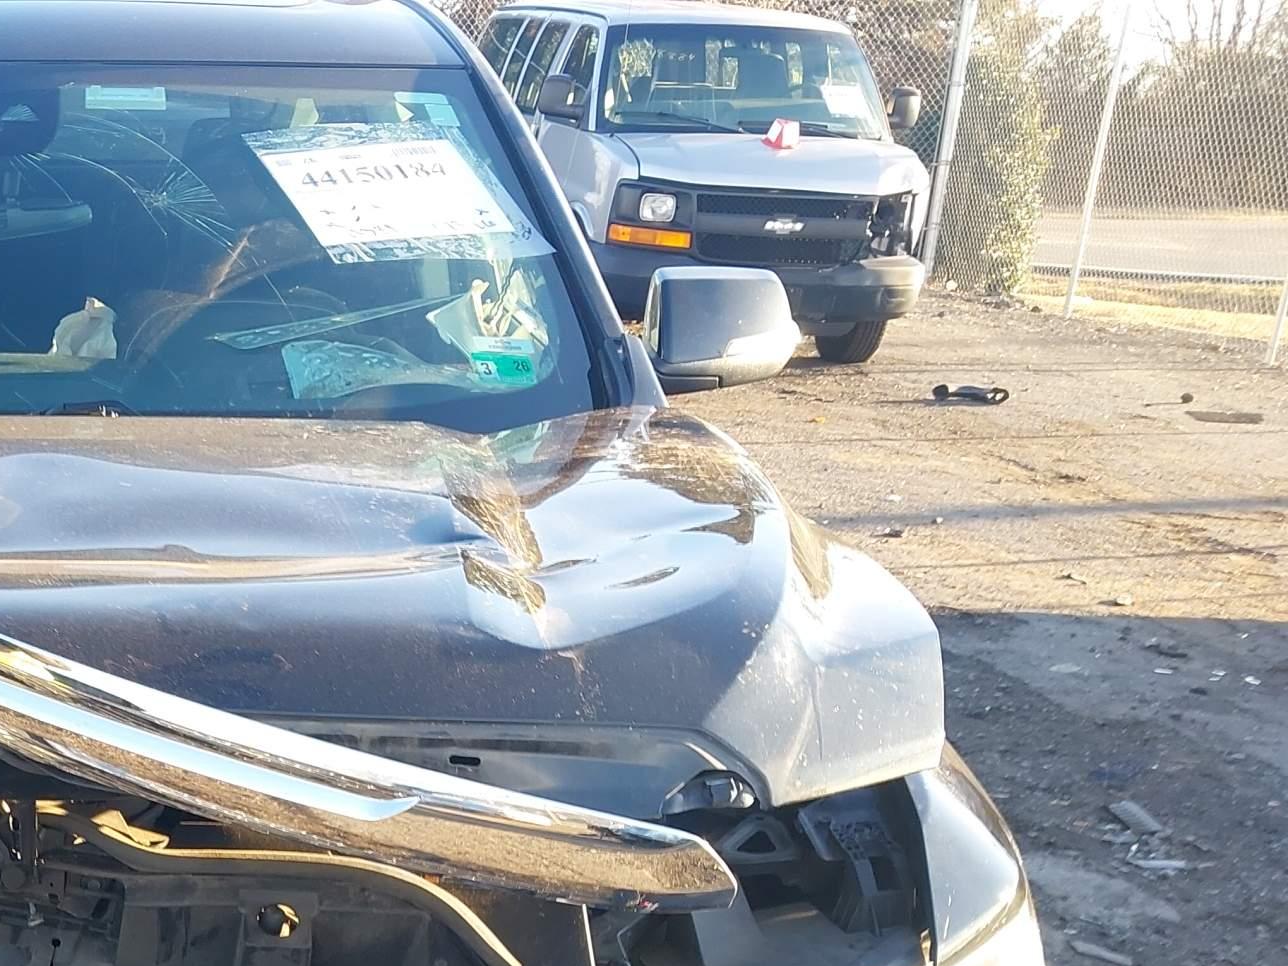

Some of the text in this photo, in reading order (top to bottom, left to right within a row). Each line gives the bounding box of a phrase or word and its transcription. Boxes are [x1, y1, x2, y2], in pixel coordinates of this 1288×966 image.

[301, 161, 447, 187] 44150184
[480, 362, 492, 375] 3
[512, 360, 530, 373] 26
